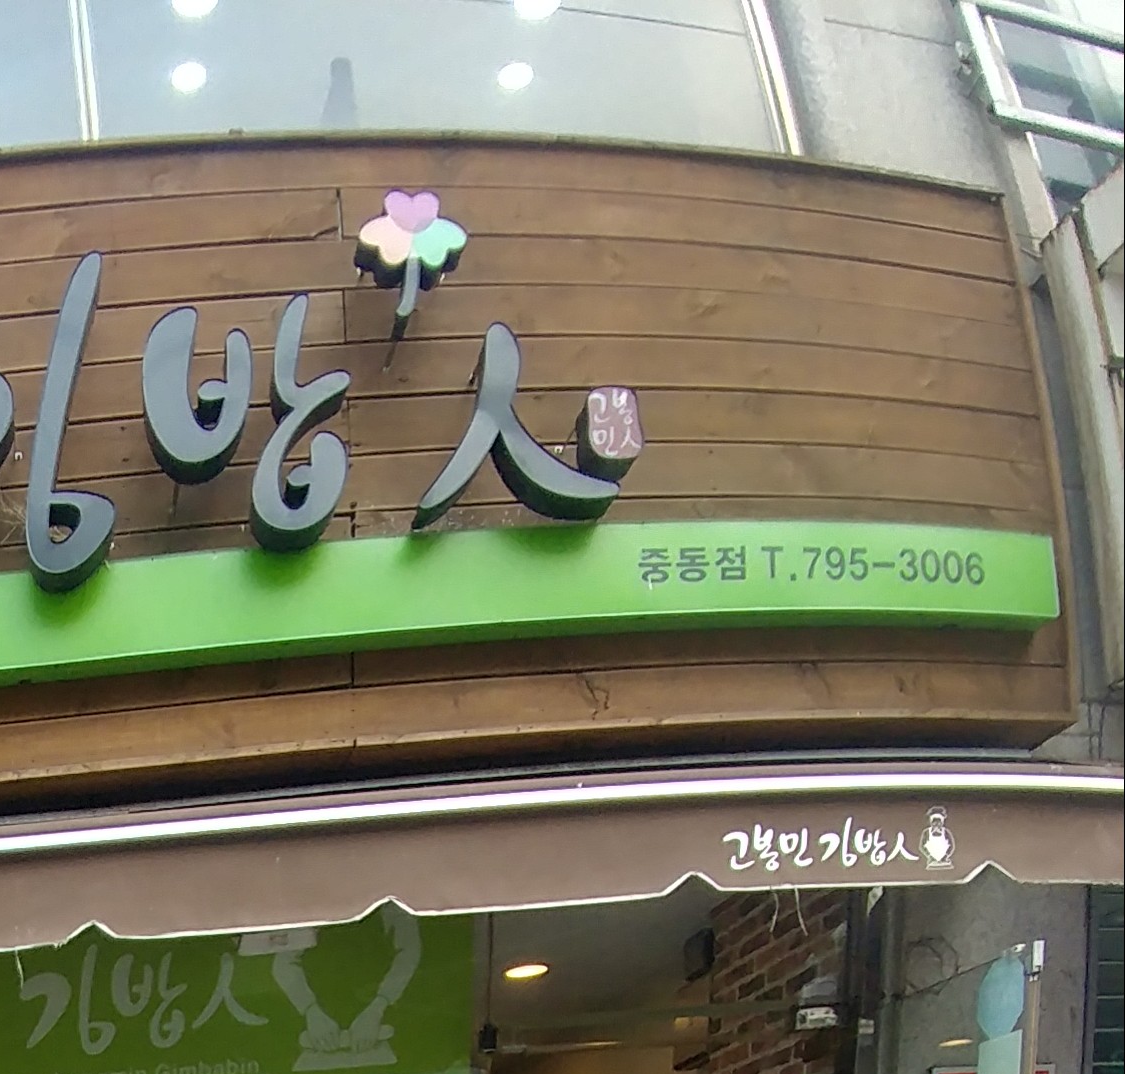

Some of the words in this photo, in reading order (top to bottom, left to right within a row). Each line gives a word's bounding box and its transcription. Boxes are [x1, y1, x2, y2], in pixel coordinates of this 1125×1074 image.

[588, 387, 635, 426] 고봉
[637, 546, 747, 584] 중동점
[760, 545, 986, 587] T.795-3006
[721, 821, 813, 871] 고봉민
